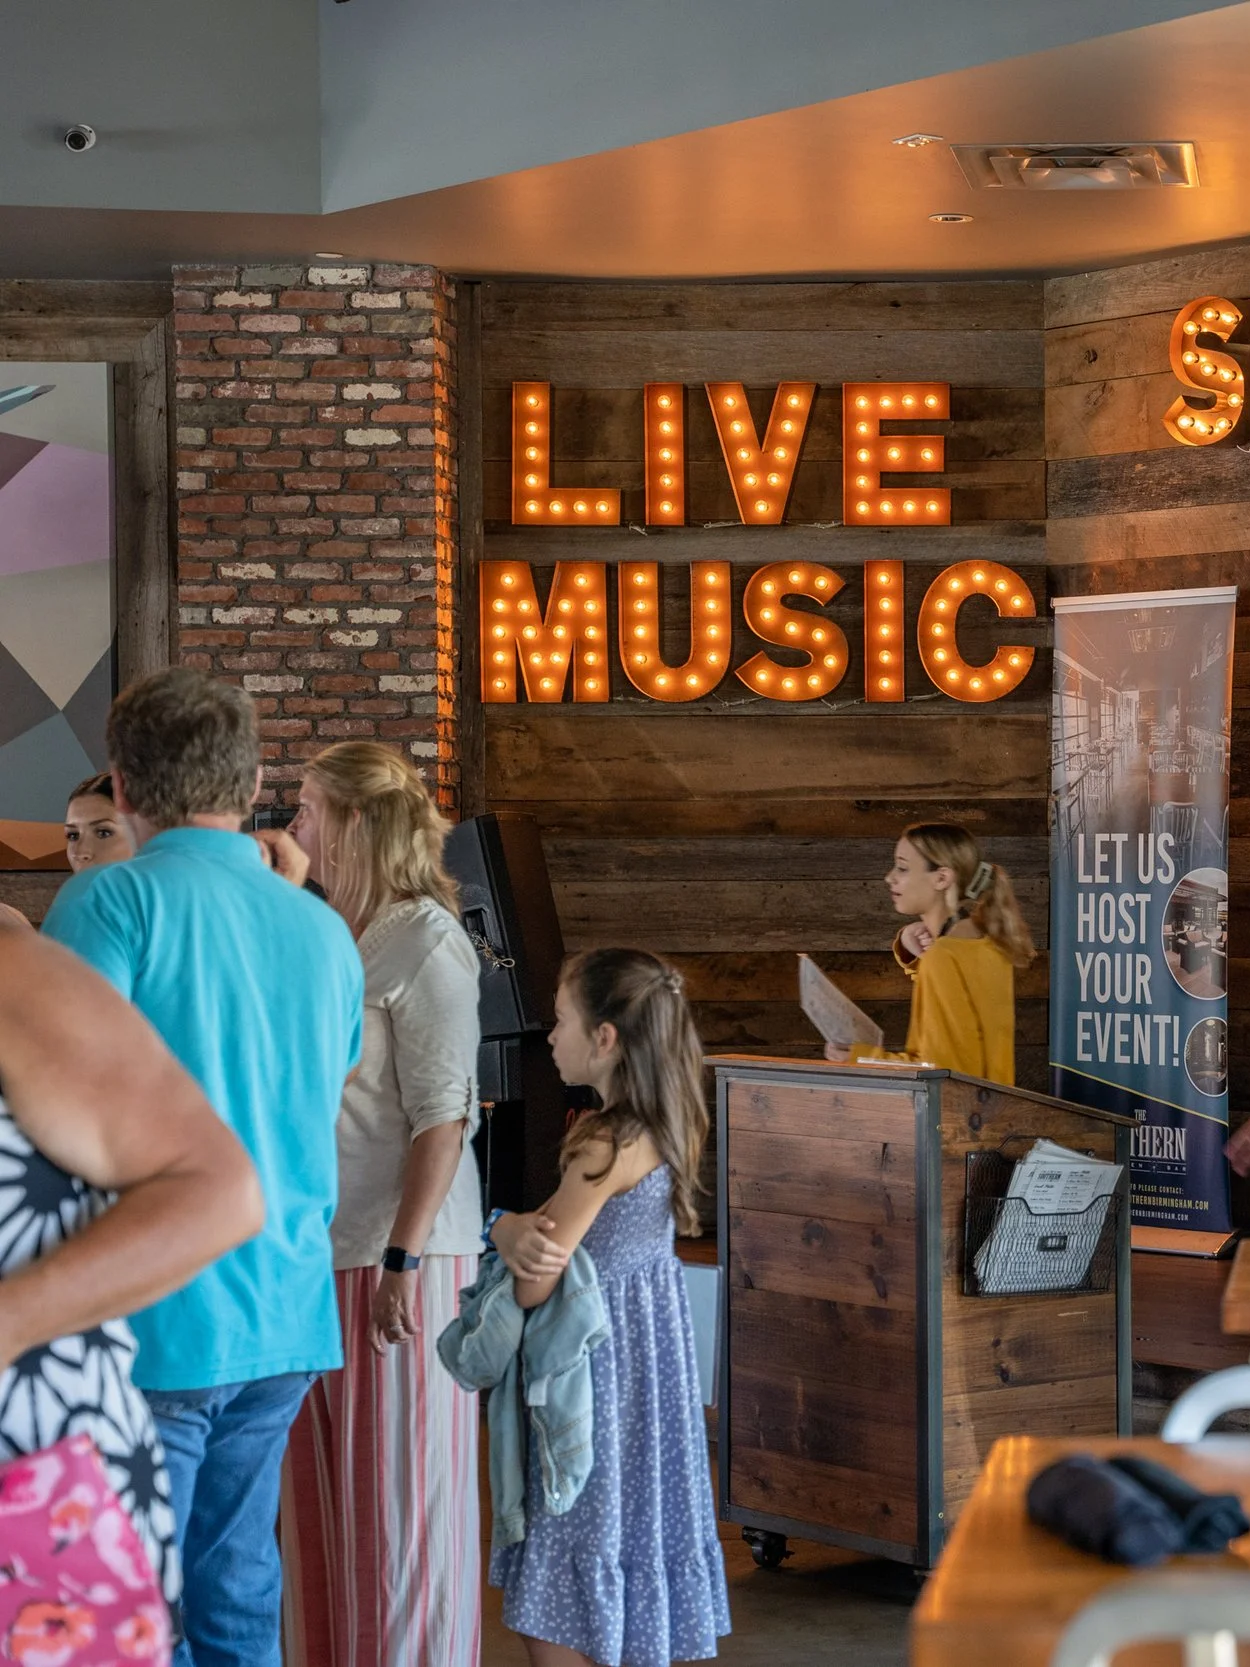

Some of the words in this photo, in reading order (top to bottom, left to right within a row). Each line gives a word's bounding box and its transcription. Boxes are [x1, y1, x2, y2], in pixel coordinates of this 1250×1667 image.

[511, 381, 952, 526] LIVE
[479, 560, 1037, 703] MUSIC
[1077, 833, 1128, 884] LET
[1138, 833, 1175, 885] US
[1077, 892, 1152, 944] HOST
[1075, 951, 1152, 1004] YOUR
[1076, 1011, 1180, 1067] EVENT!
[1134, 1109, 1147, 1121] THE
[1130, 1124, 1187, 1162] THERN
[1131, 1194, 1209, 1211] THERNBIRMINGHAM.COM
[1131, 1209, 1189, 1221] ERNBIRMINGHAM.COM
[1138, 1184, 1157, 1193] PLEASE
[1160, 1186, 1185, 1195] CONTACT:
